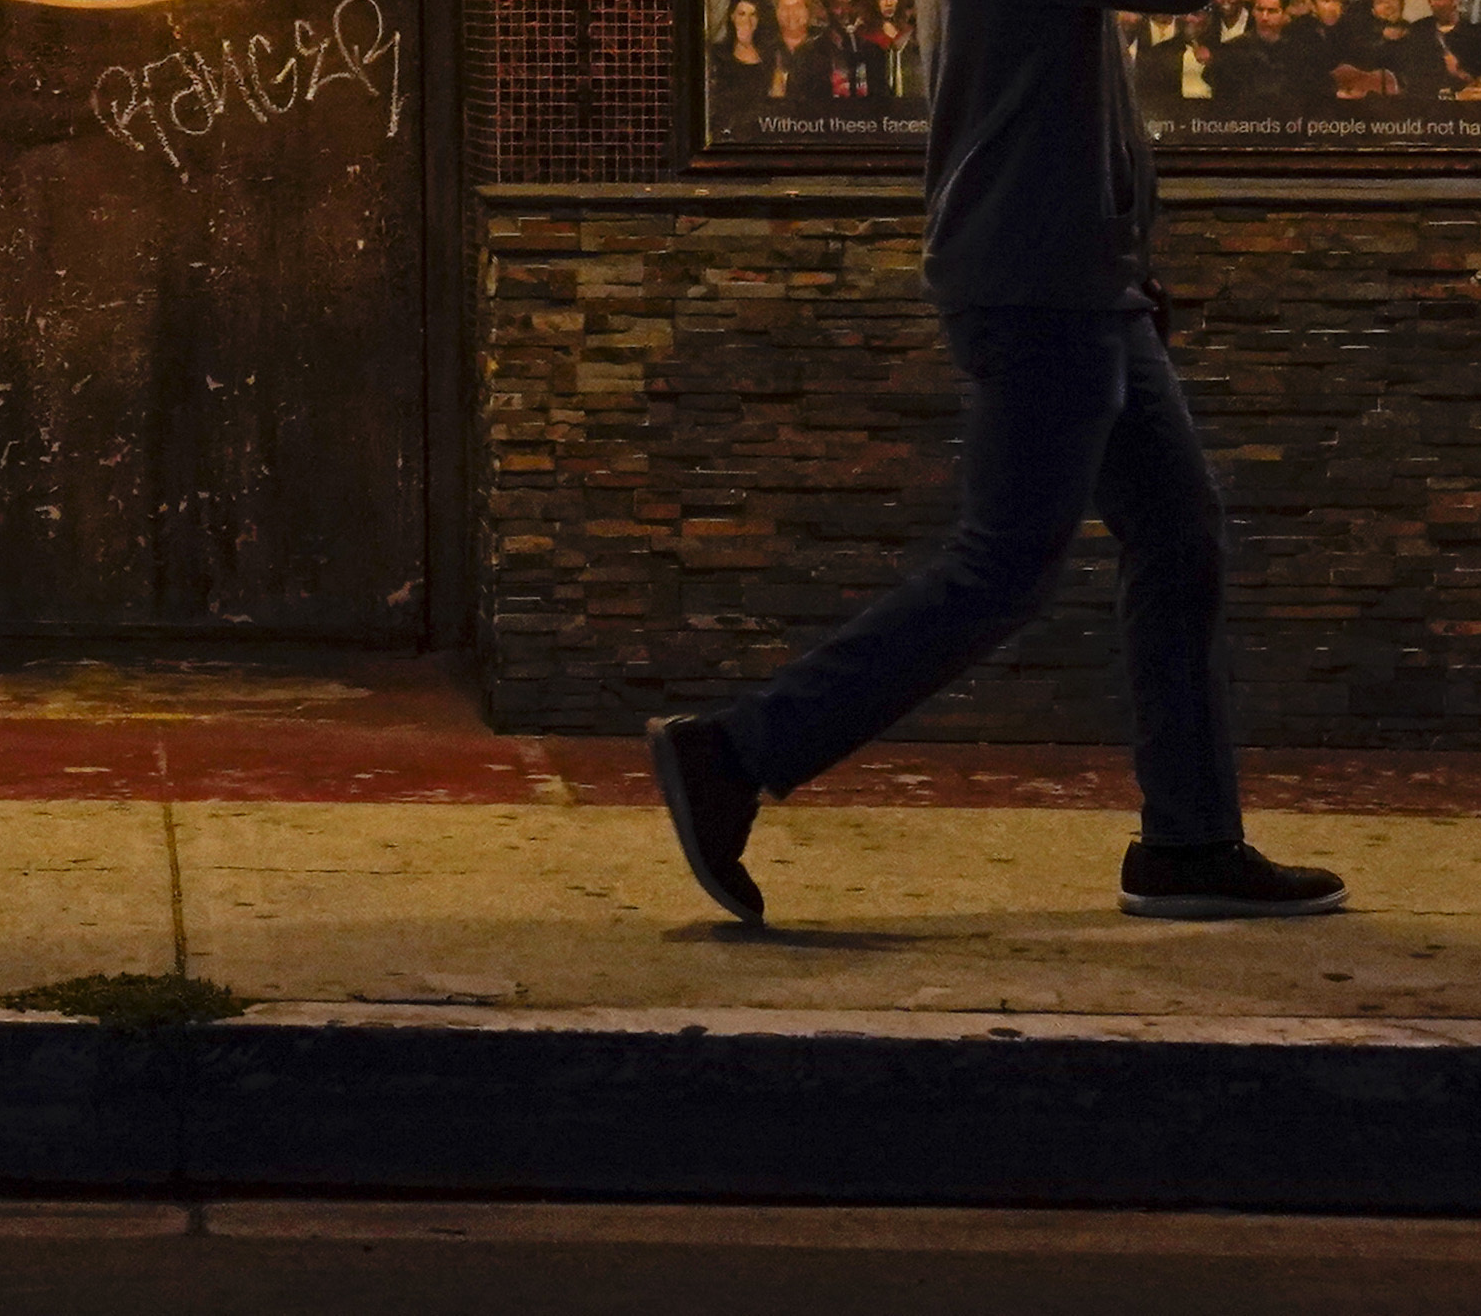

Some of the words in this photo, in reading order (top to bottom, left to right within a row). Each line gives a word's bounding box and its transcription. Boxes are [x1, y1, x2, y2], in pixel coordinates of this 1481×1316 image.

[758, 116, 825, 134] Without
[830, 116, 877, 134] these
[882, 115, 929, 134] faces
[1191, 118, 1282, 135] thousands
[1287, 117, 1303, 135] of
[1307, 118, 1367, 138] people
[1371, 117, 1422, 135] would
[1427, 120, 1455, 136] not
